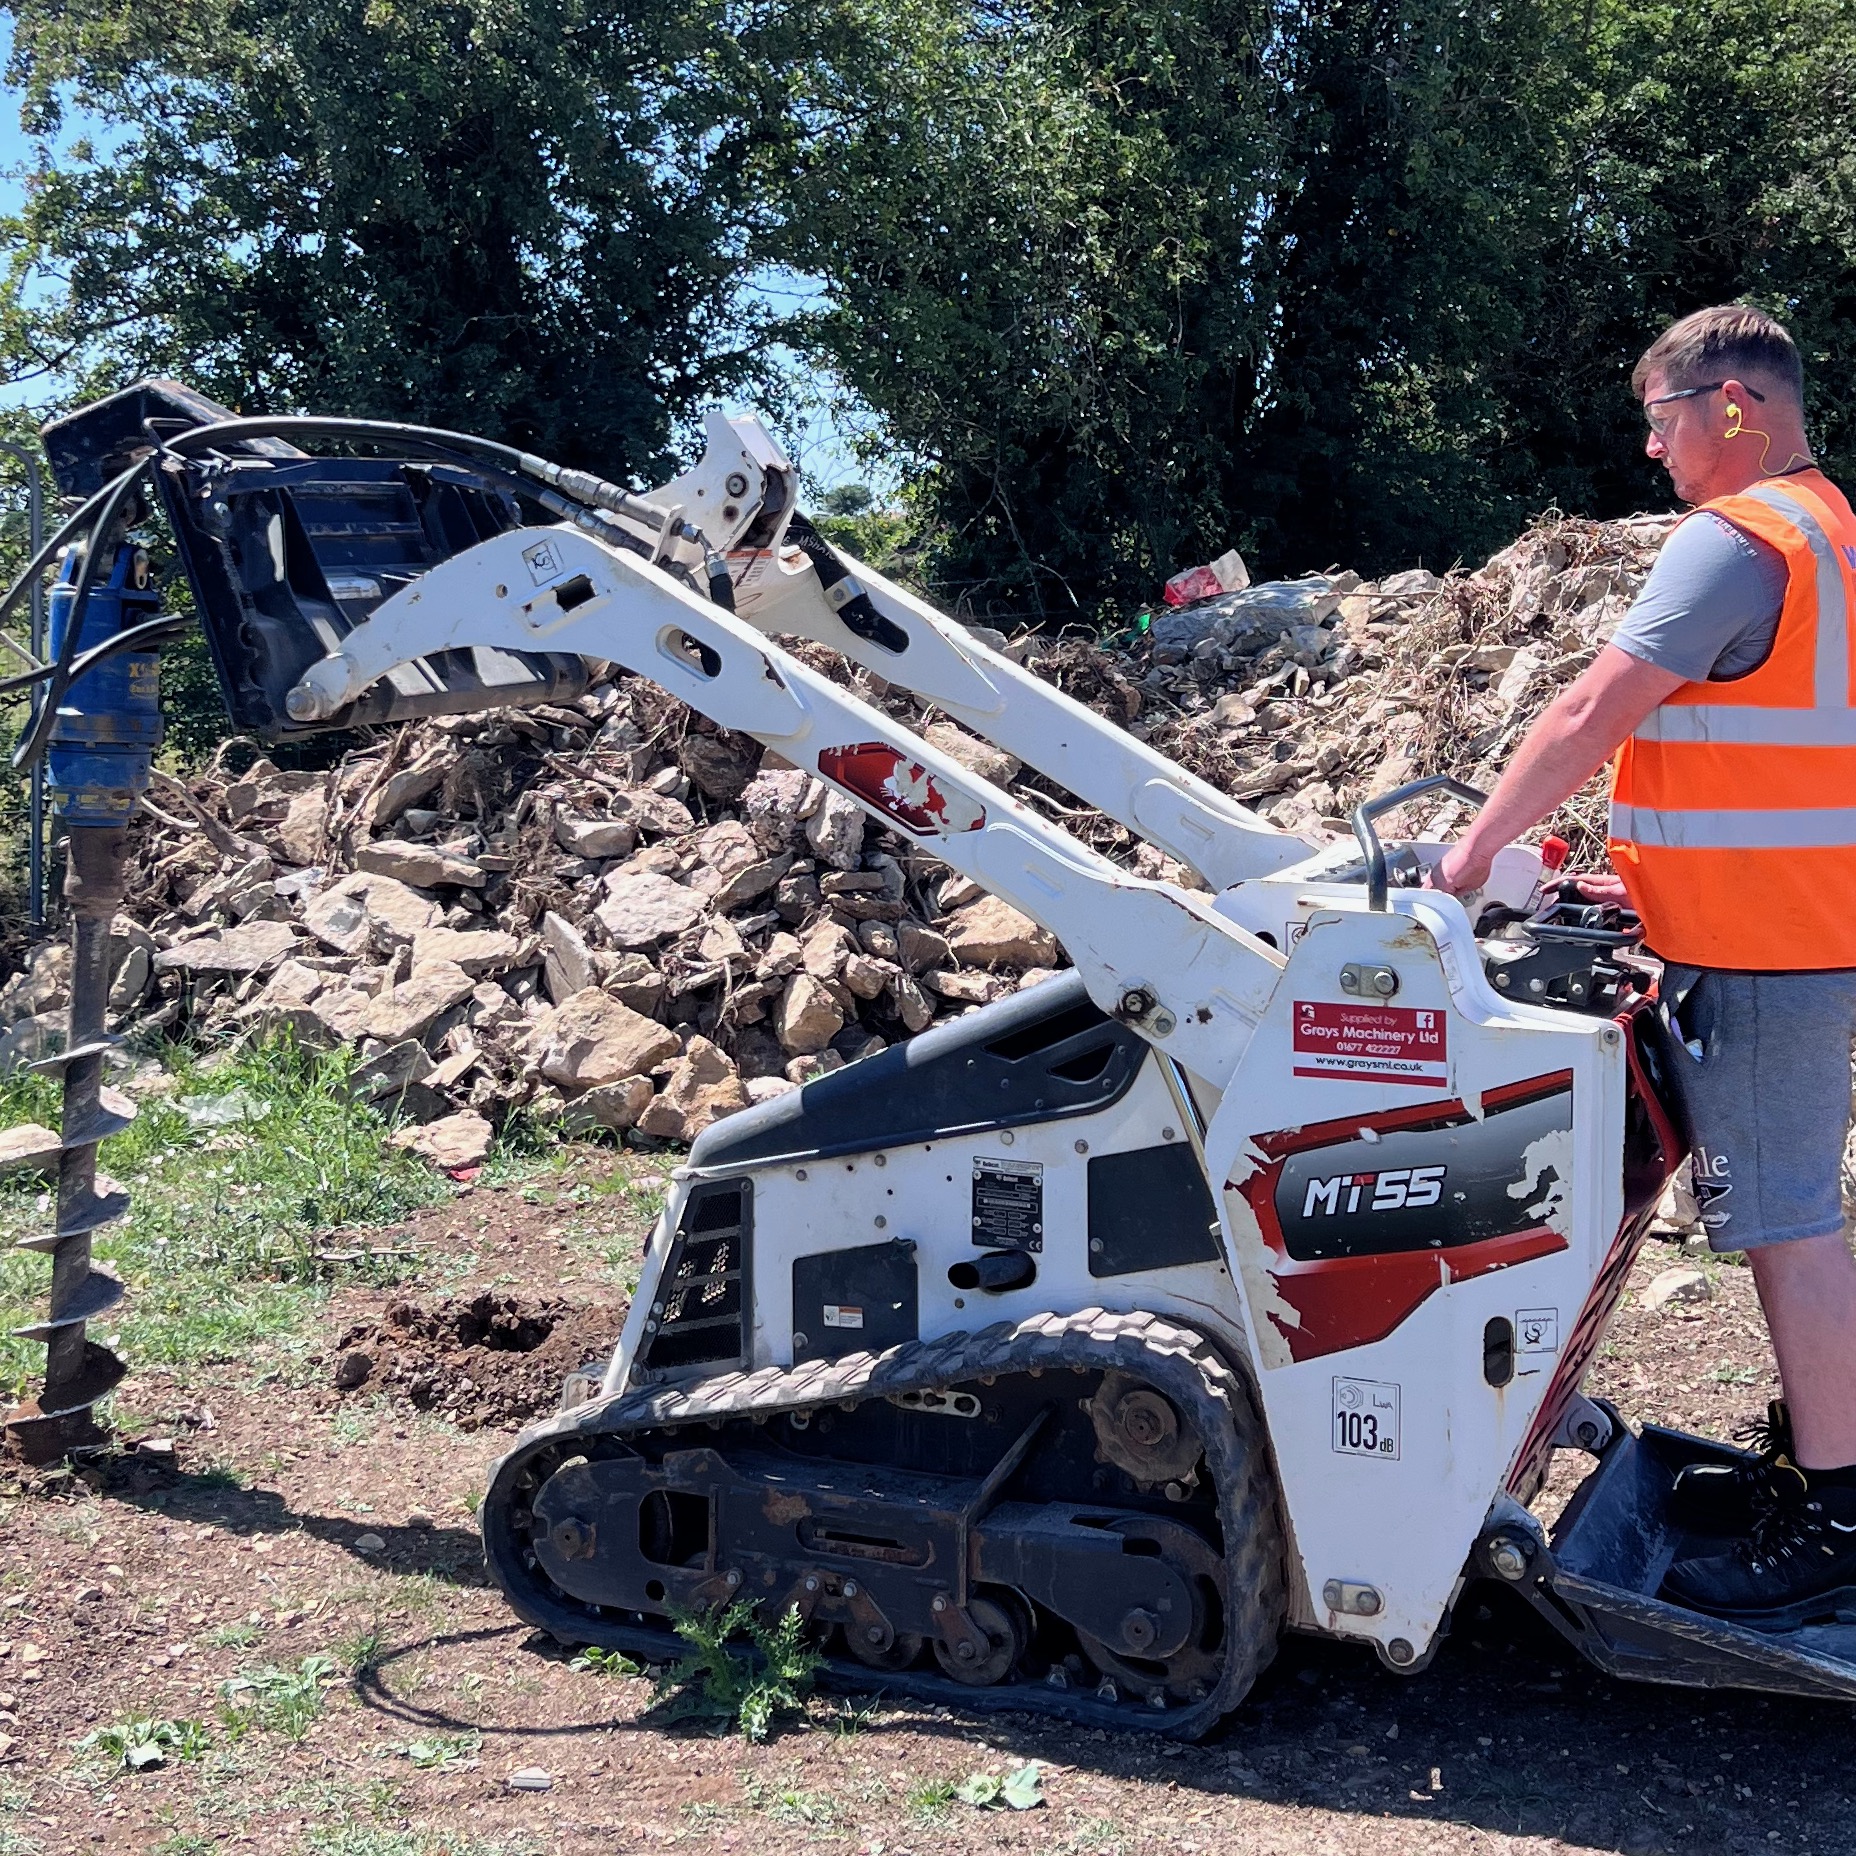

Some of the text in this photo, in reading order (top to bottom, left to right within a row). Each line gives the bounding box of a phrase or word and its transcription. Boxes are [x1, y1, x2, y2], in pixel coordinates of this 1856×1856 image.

[1340, 1012, 1398, 1027] Supplied by
[1300, 1023, 1439, 1045] Grays Machinery Ltd
[1337, 1410, 1394, 1453] 103 dB
